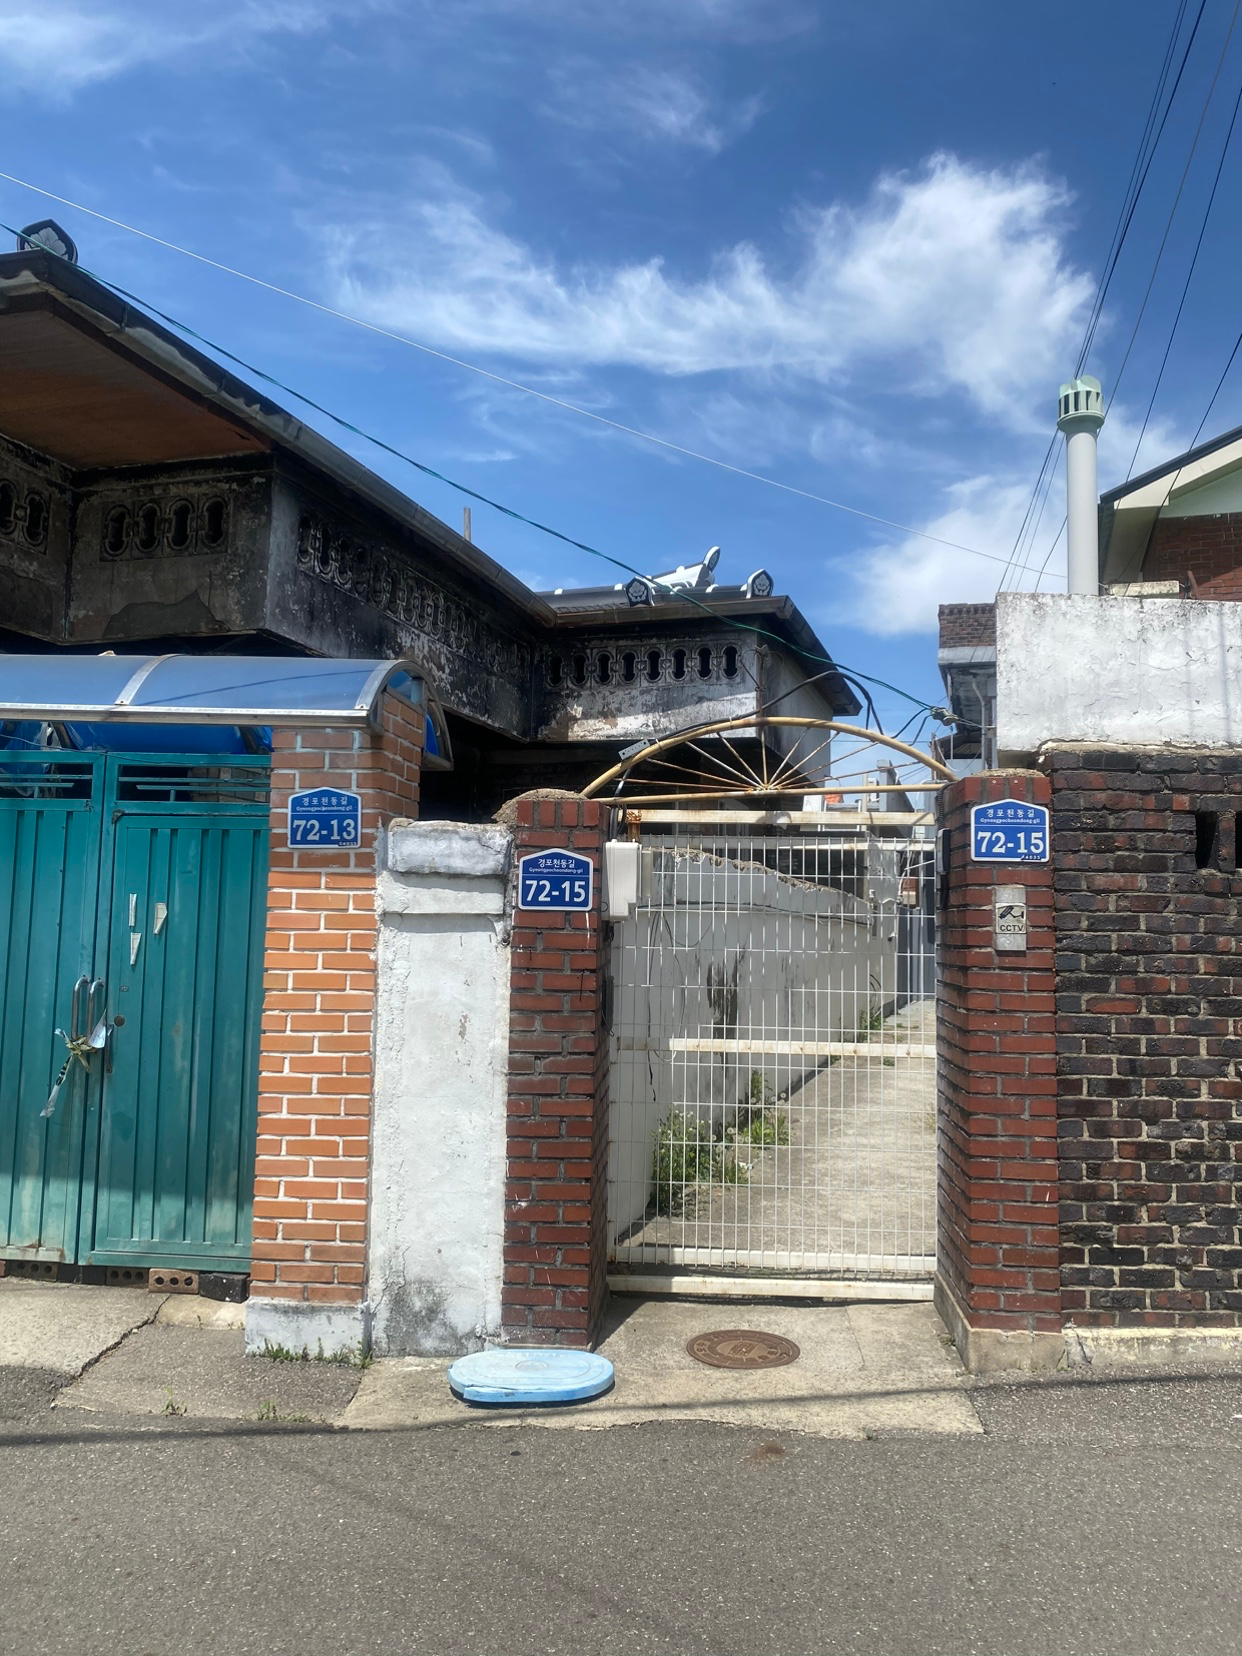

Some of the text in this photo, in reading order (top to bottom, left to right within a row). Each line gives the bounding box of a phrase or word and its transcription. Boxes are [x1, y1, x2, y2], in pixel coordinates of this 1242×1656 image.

[302, 796, 348, 805] 경포천동길
[986, 808, 1035, 818] 경포천동길
[293, 818, 356, 841] 72-13
[977, 831, 1044, 854] 72-15
[538, 858, 575, 868] 경포천동길
[525, 880, 586, 902] 72-15
[999, 924, 1024, 932] CCTV
